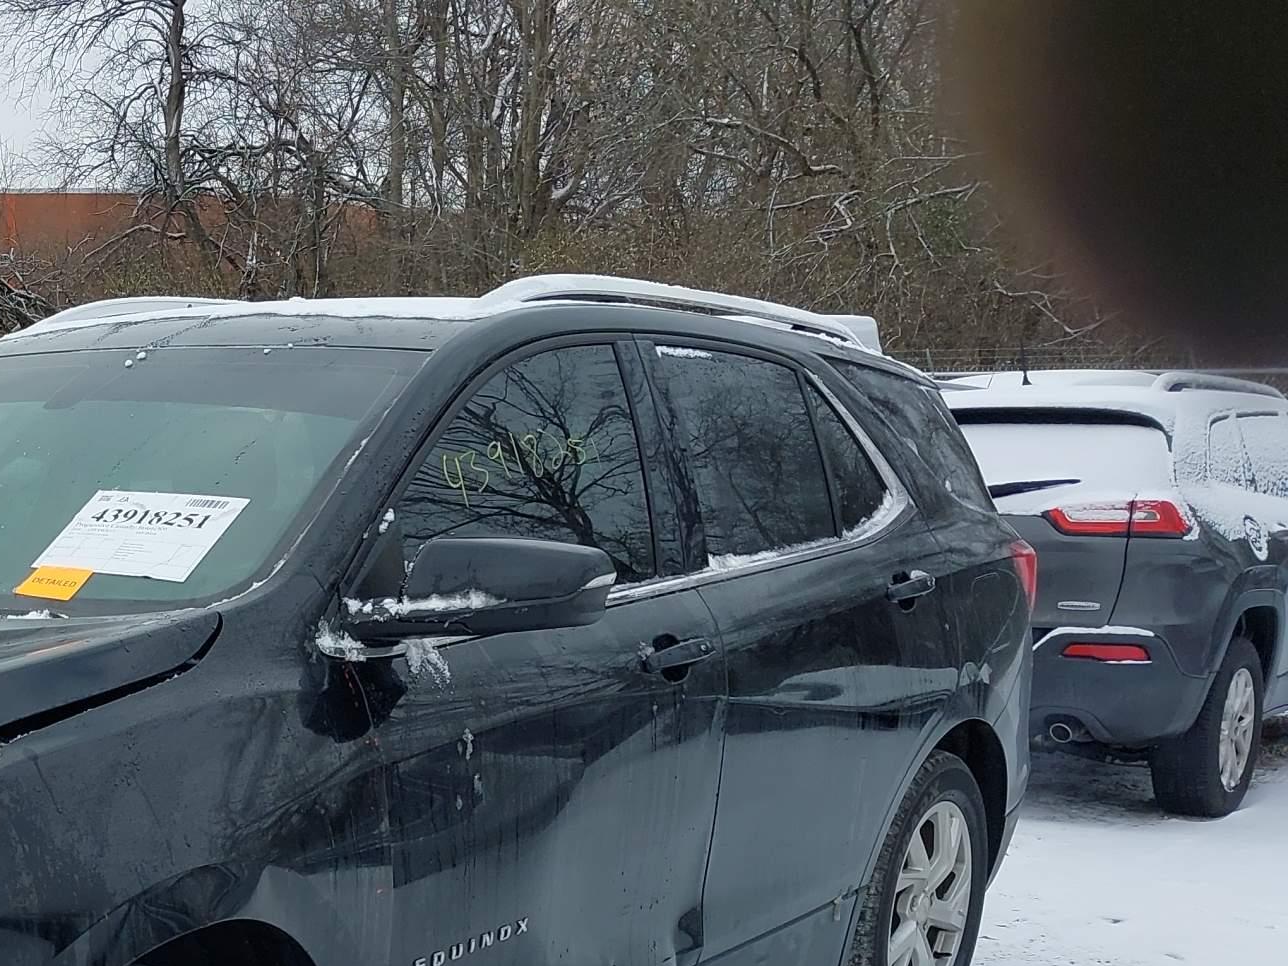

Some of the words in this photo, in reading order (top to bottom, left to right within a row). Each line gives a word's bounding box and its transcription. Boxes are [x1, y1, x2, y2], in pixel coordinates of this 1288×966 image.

[442, 428, 602, 508] 43918251
[91, 508, 212, 529] 43918251
[31, 576, 77, 588] DETAILED
